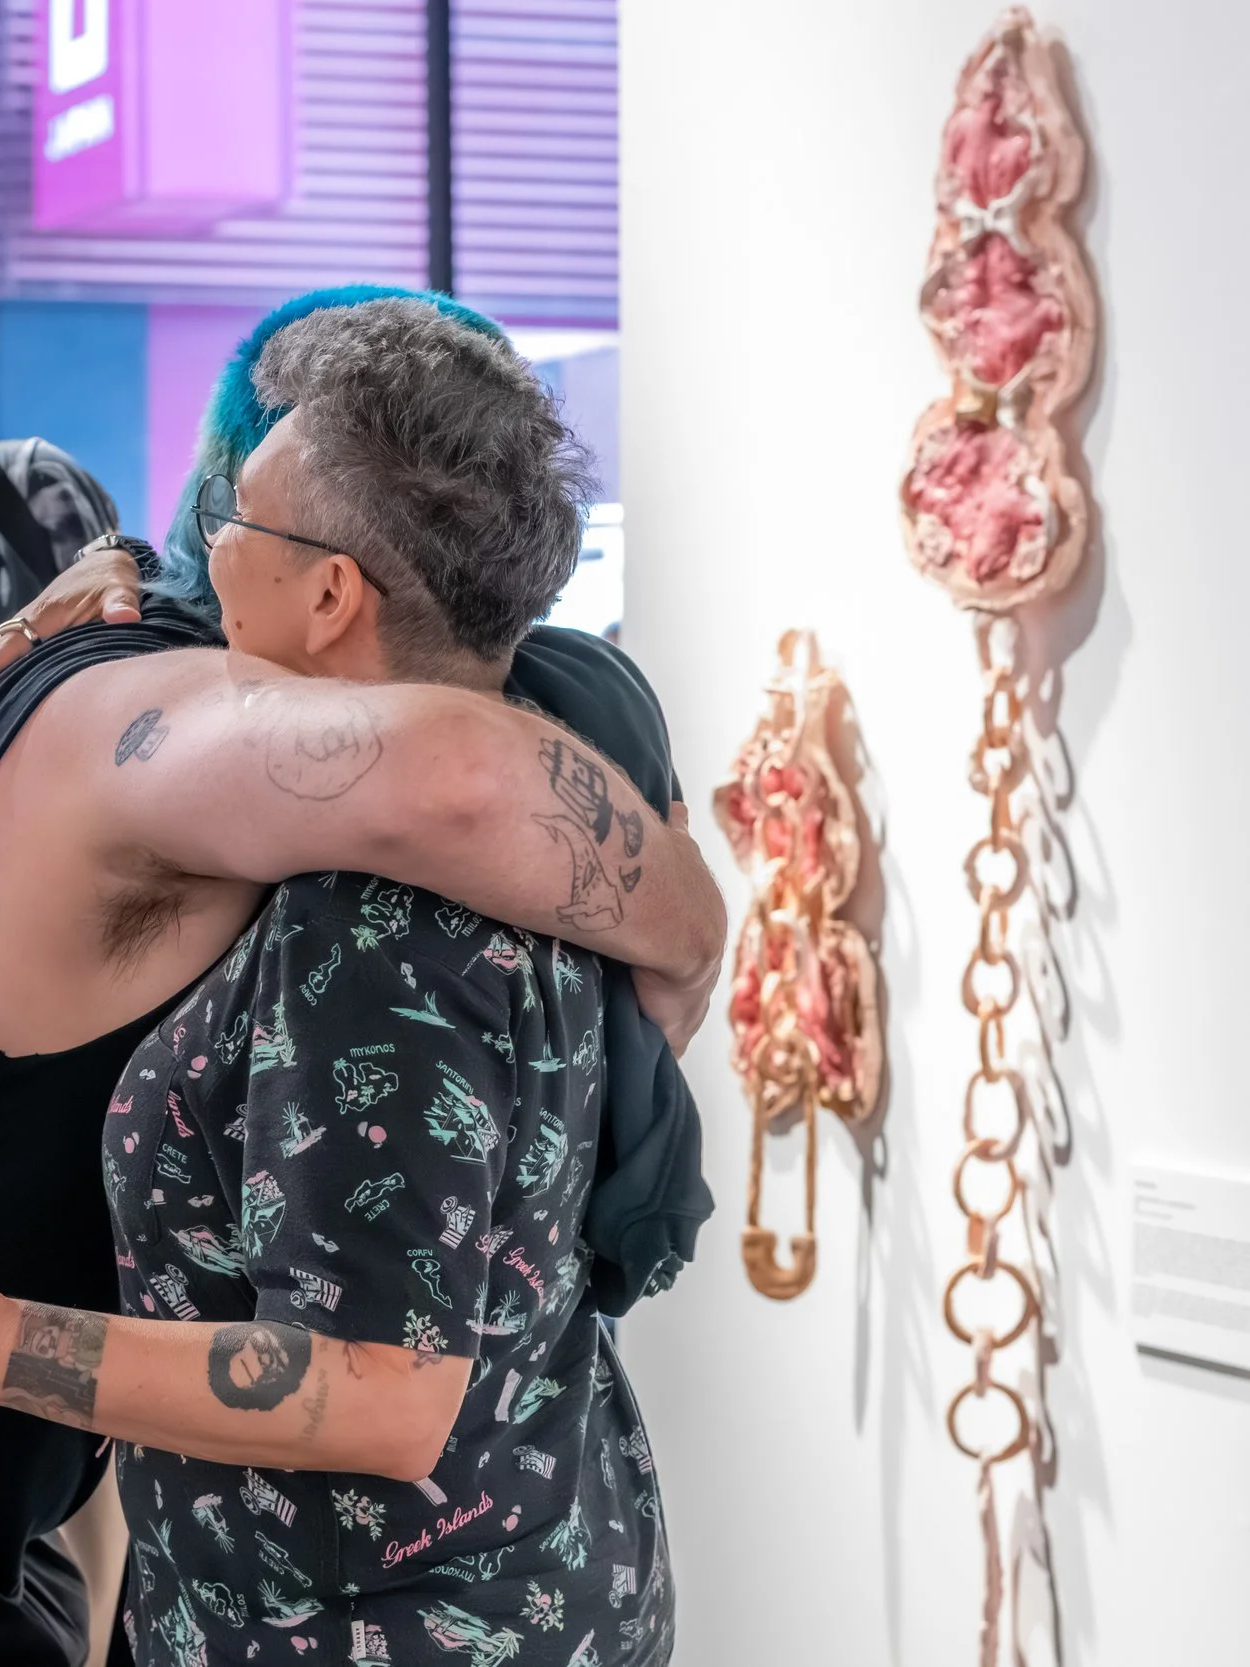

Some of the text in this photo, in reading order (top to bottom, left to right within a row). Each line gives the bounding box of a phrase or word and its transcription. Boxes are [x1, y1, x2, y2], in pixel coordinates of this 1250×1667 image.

[349, 1043, 396, 1058] MYKONOS
[435, 1060, 474, 1095] SANTORINI
[162, 1143, 188, 1164] CRETE
[364, 1199, 390, 1222] CRETE
[406, 1249, 433, 1257] CORFU
[503, 1246, 532, 1278] Greek
[381, 1490, 494, 1569] Greek Islands
